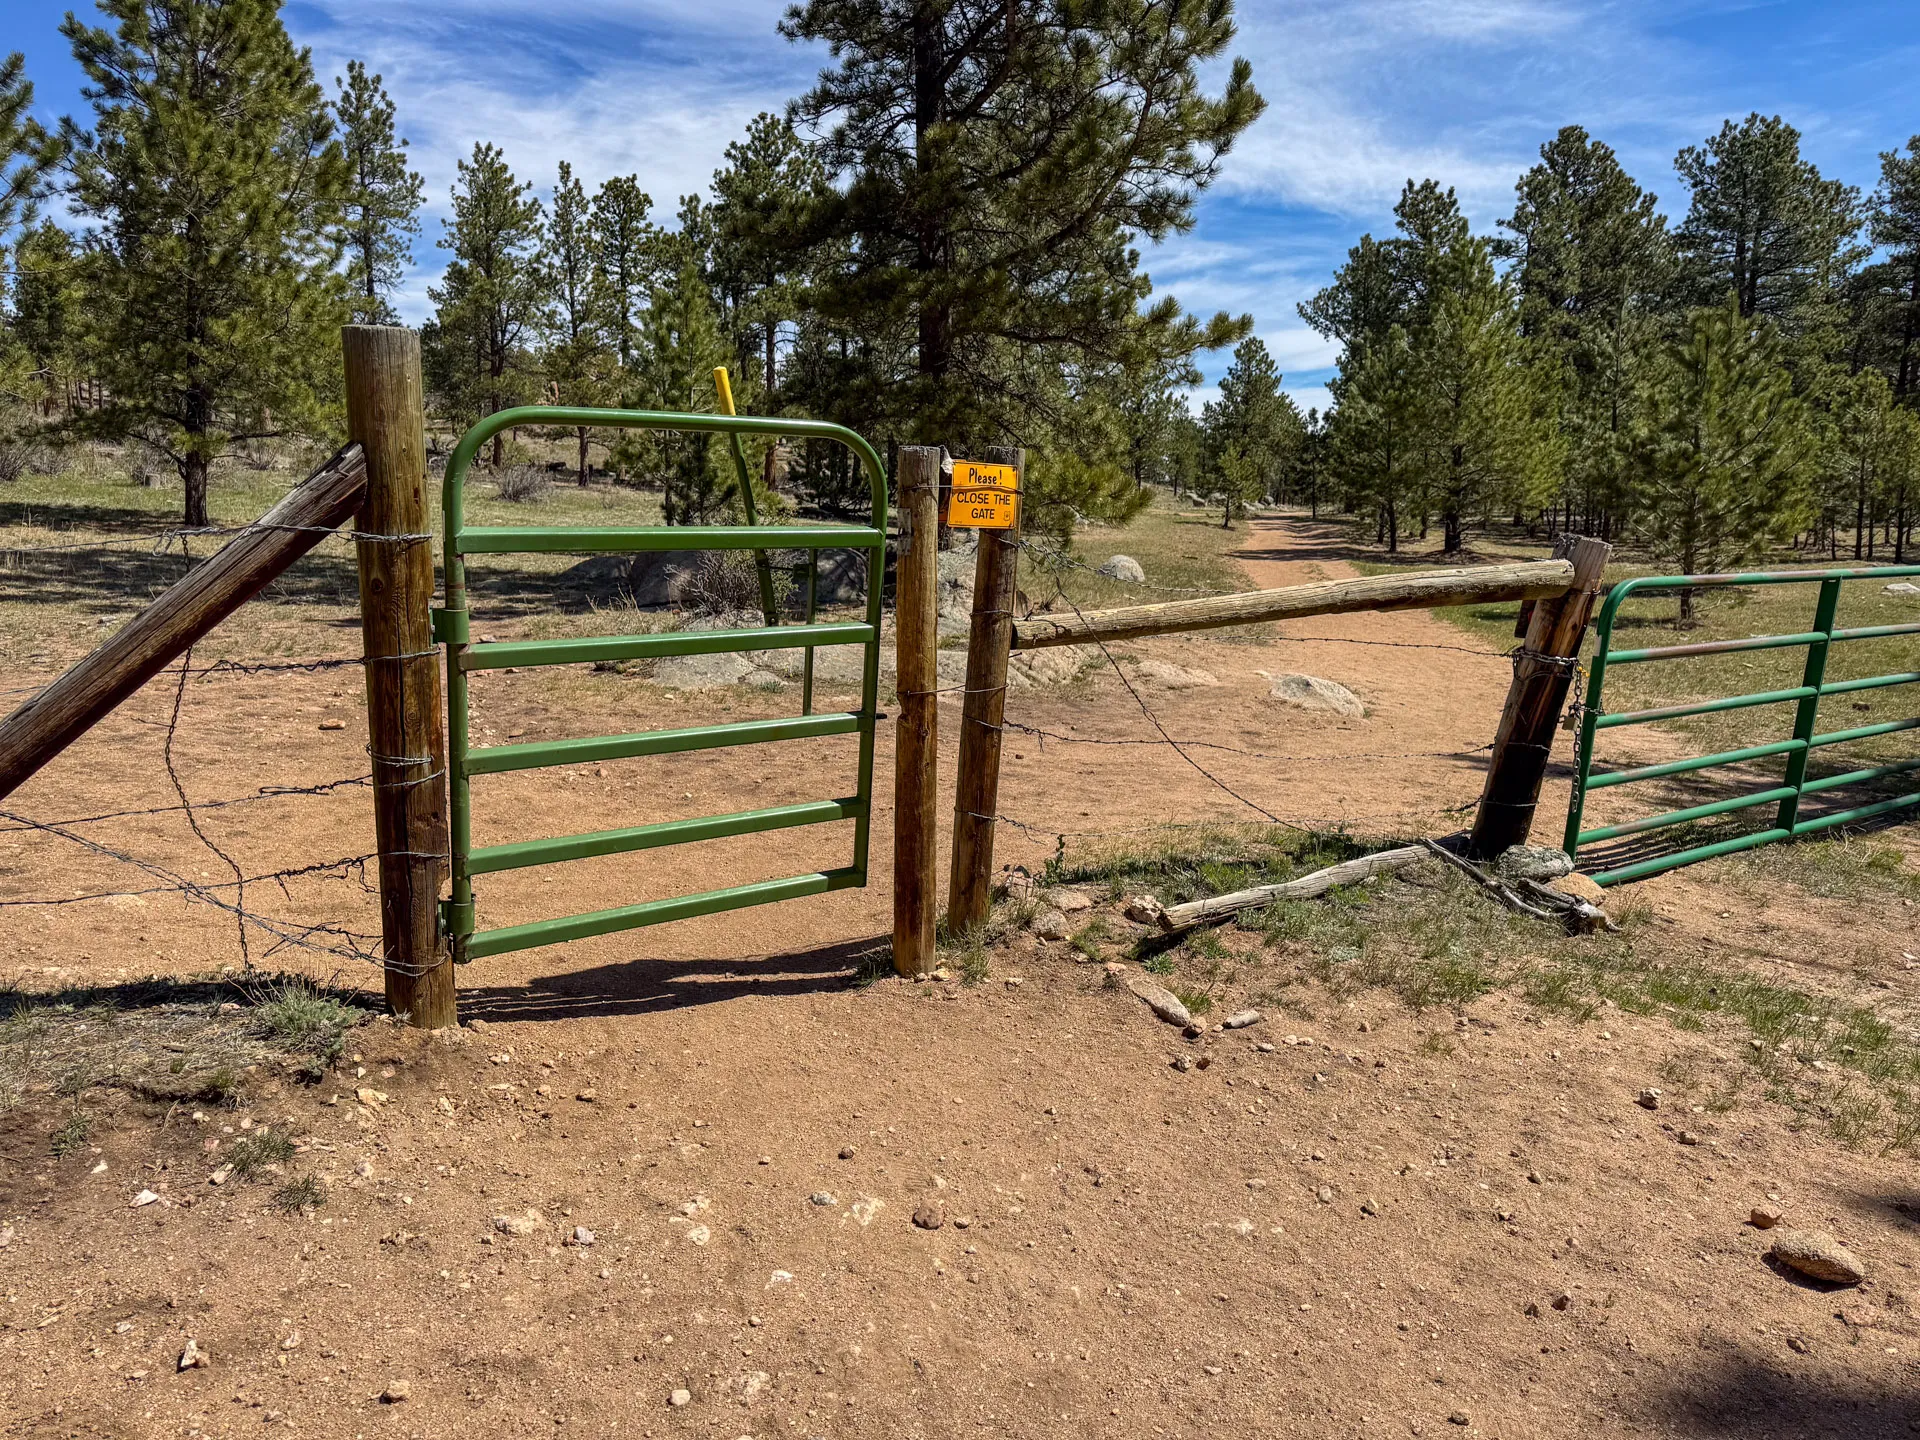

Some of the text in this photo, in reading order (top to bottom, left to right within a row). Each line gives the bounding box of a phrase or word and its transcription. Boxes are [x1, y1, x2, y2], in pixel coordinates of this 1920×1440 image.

[956, 491, 1011, 505] CLOSE THE
[971, 508, 995, 519] GATE
